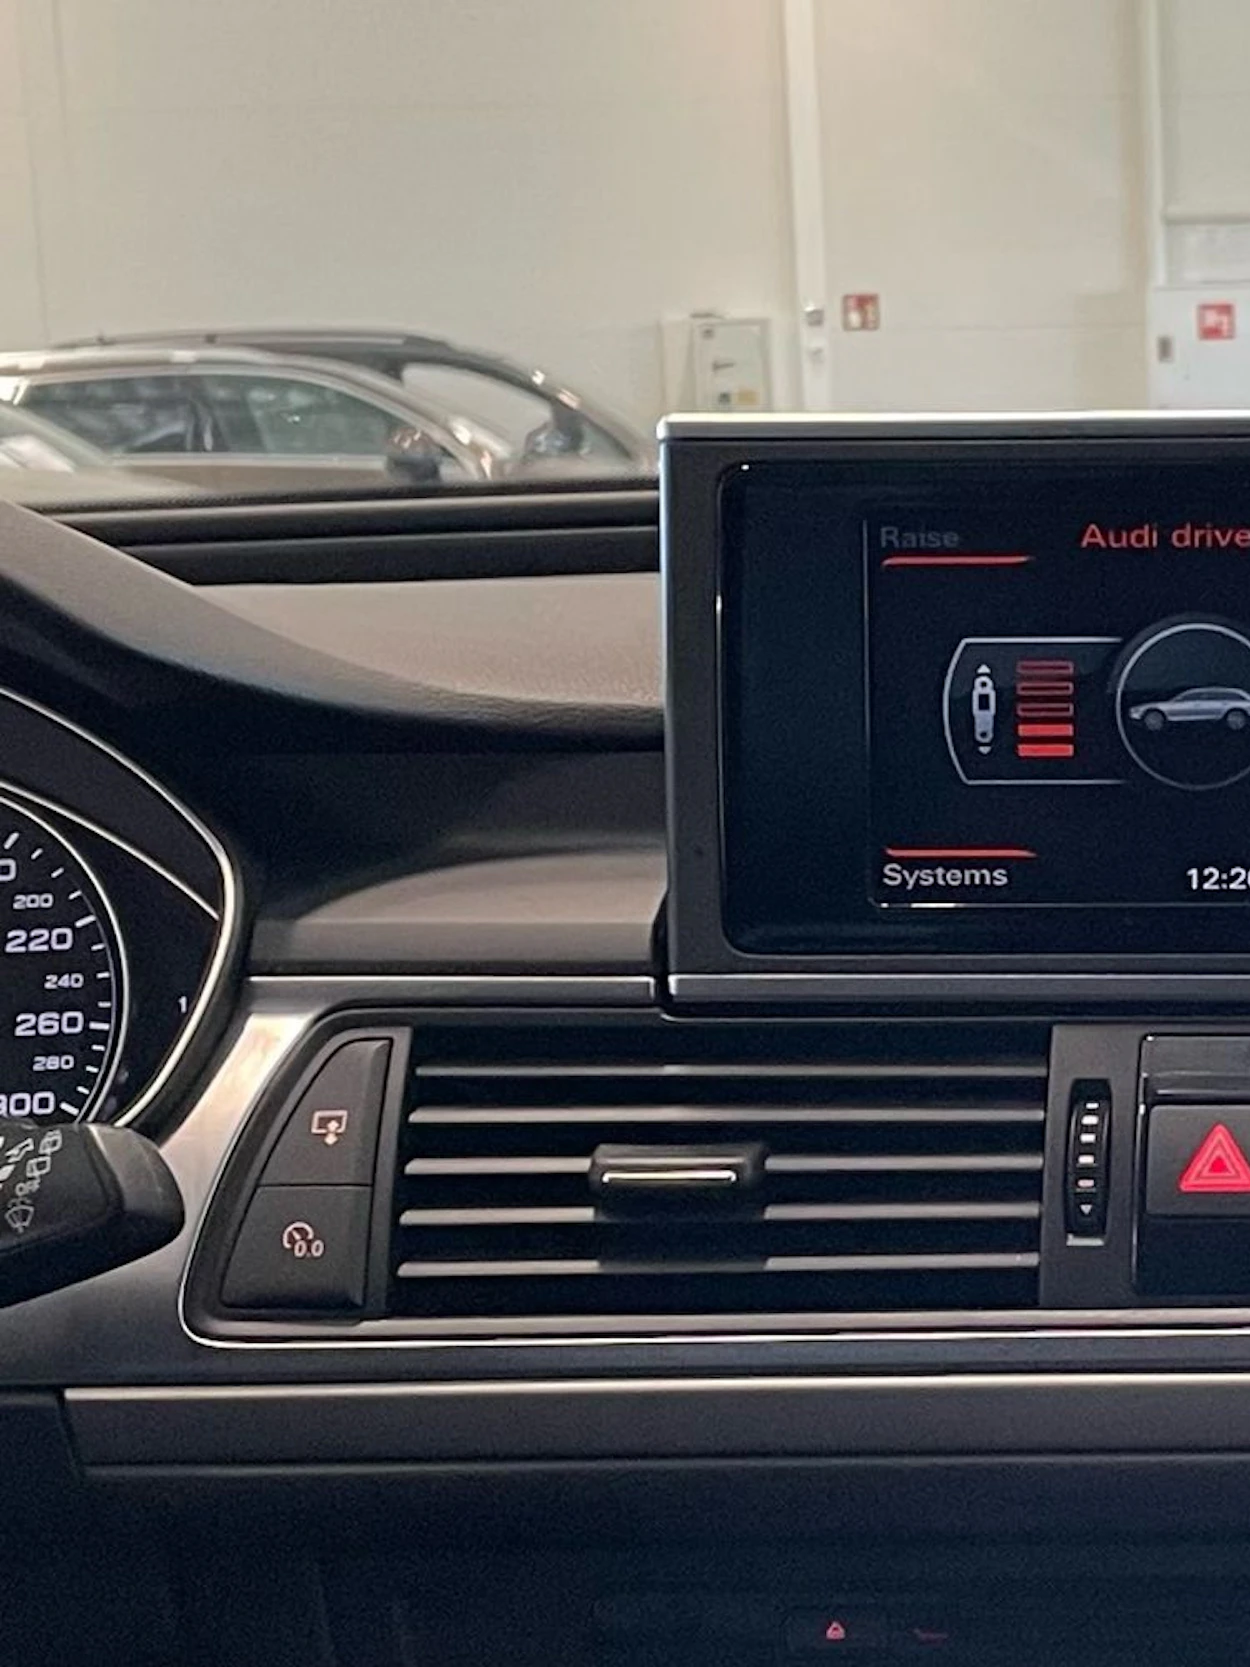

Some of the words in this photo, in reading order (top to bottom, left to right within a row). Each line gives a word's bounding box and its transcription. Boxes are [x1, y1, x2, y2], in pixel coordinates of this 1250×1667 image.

[880, 526, 960, 548] Raise
[1081, 523, 1158, 548] Audi
[883, 863, 1008, 890] Systems
[12, 893, 54, 910] 200
[5, 927, 73, 953] 220
[44, 973, 84, 989] 240
[15, 1011, 84, 1036] 260
[32, 1054, 75, 1071] 280
